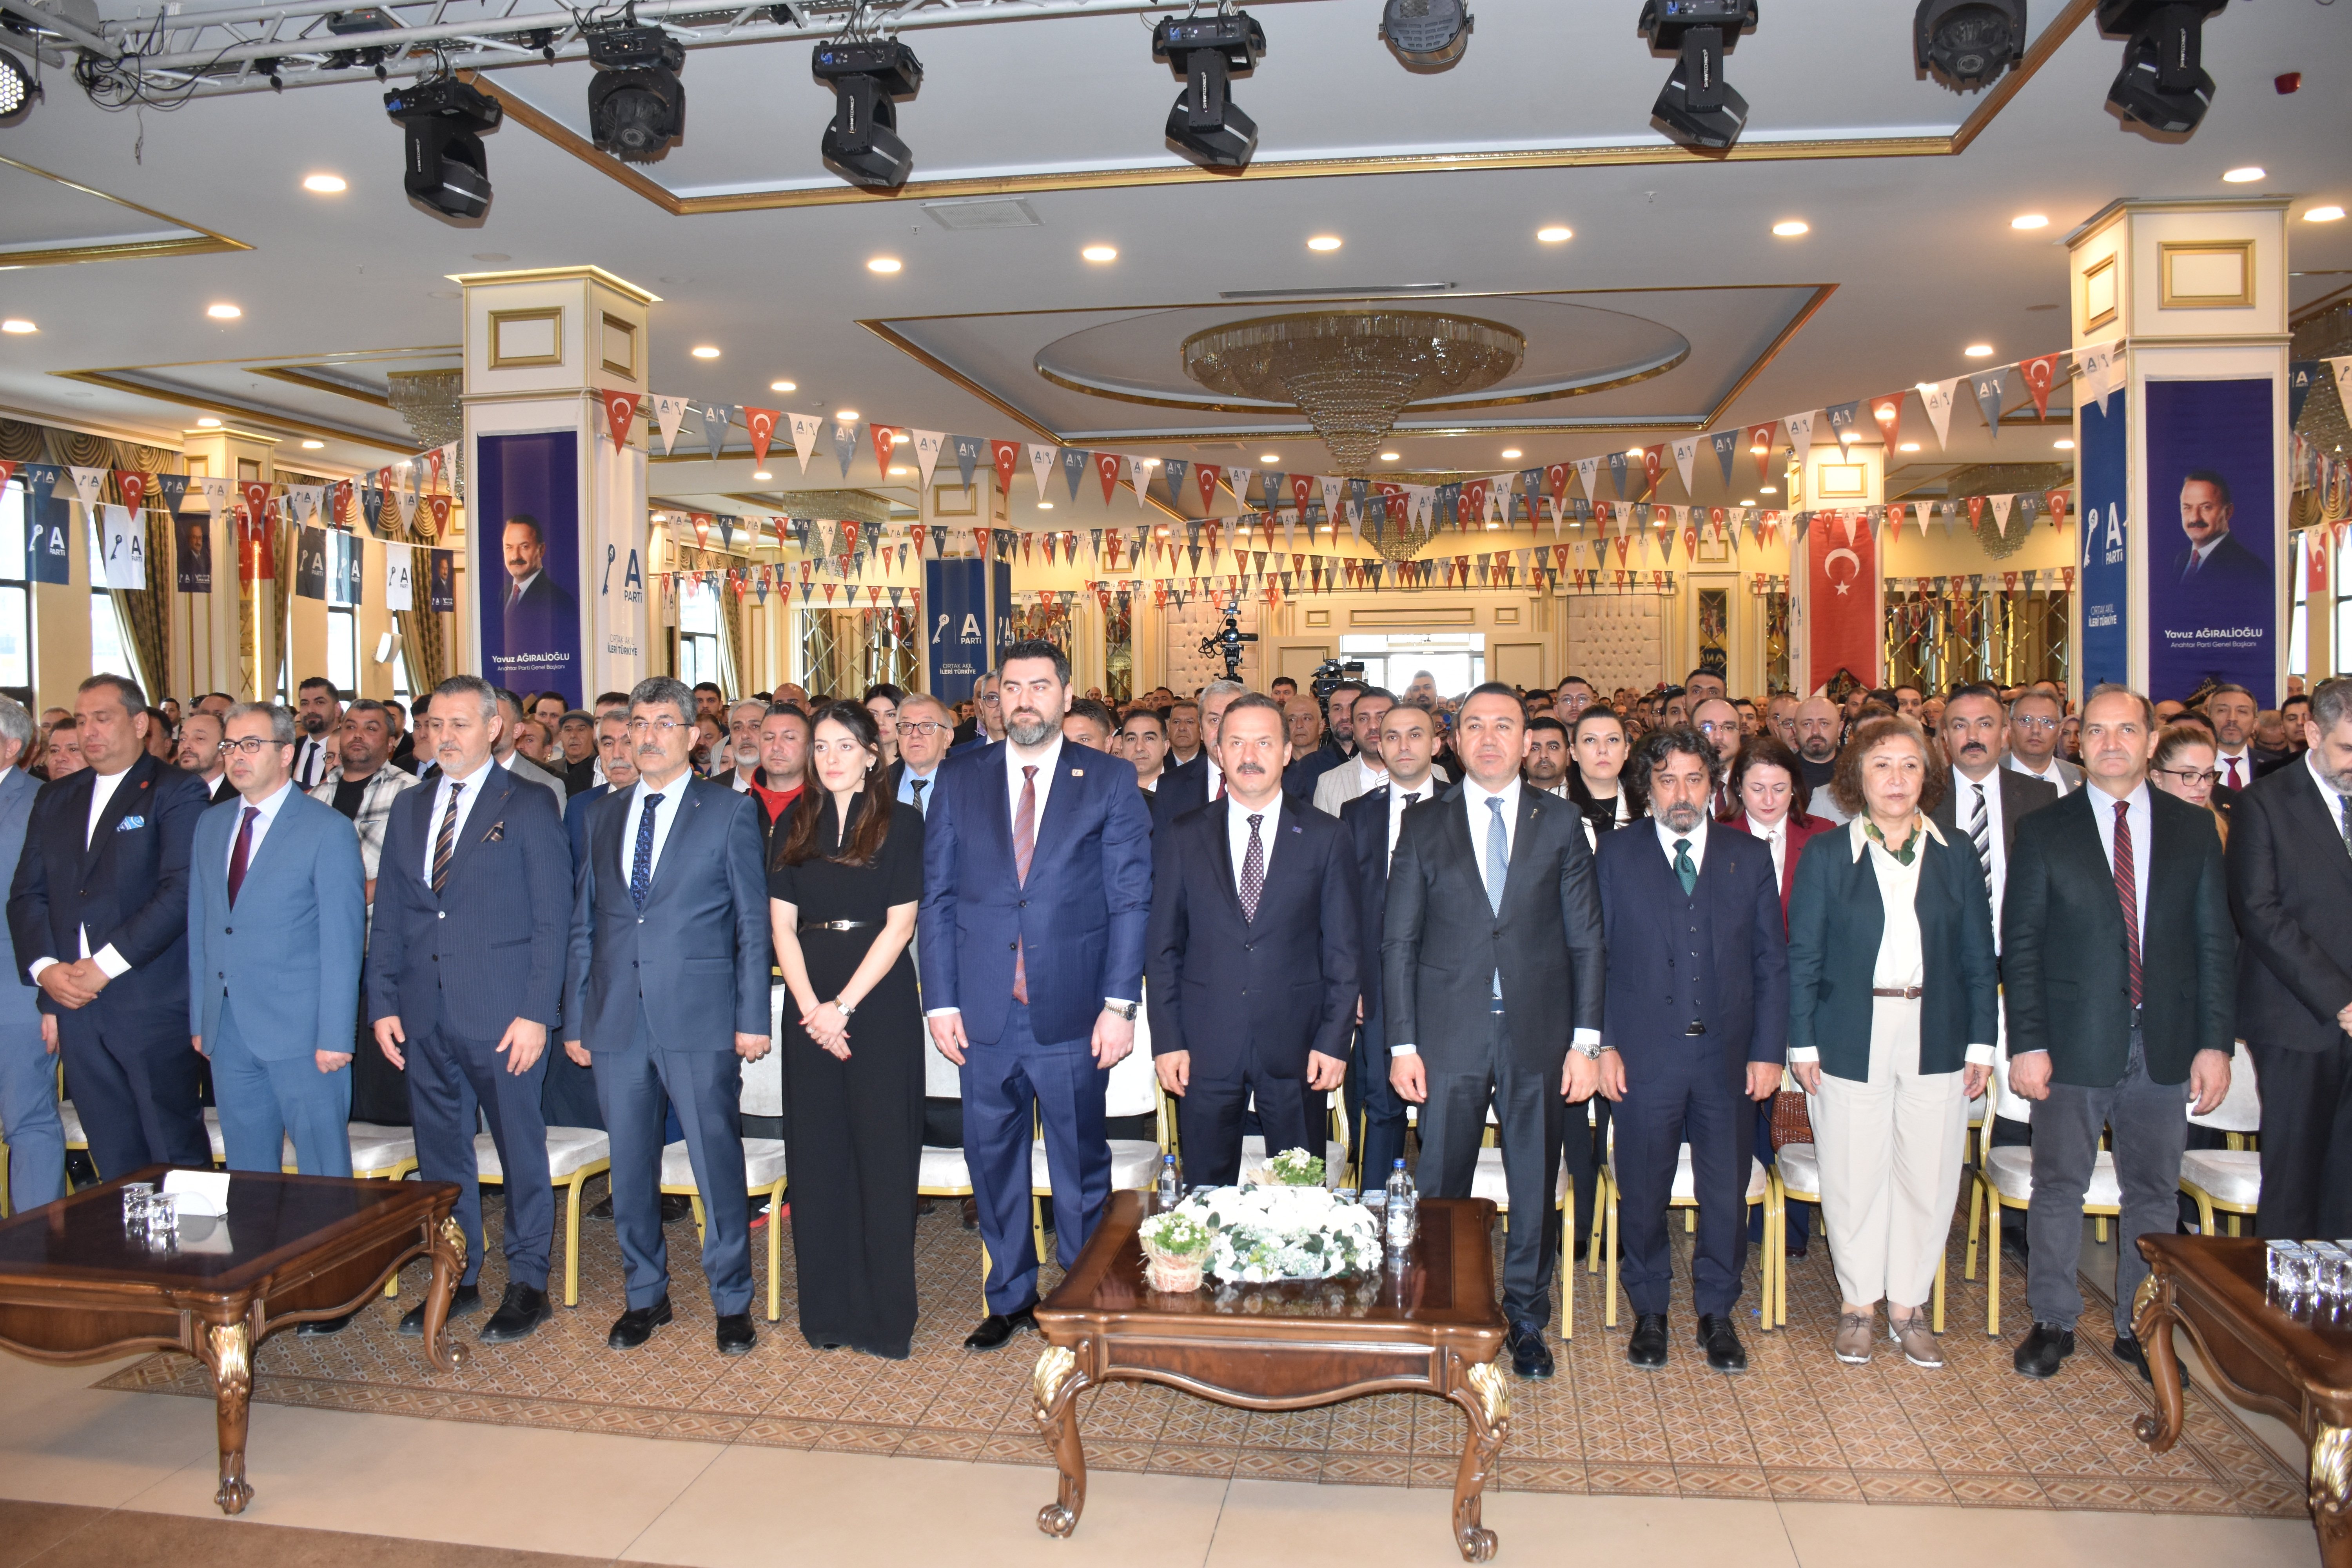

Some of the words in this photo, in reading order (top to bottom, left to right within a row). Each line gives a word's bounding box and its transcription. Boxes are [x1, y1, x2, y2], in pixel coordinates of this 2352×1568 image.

[2296, 371, 2307, 383] A
[46, 472, 54, 481] A
[91, 476, 99, 485] A
[176, 482, 183, 490] A
[218, 485, 224, 494] A
[2106, 502, 2122, 550] A
[50, 527, 65, 549] A
[132, 535, 142, 555] A
[312, 553, 323, 570] A
[352, 560, 360, 577] A
[625, 549, 642, 589] A
[401, 568, 408, 583] A
[670, 594, 673, 605] A
[961, 614, 981, 636] A
[1005, 617, 1011, 639] A
[2165, 630, 2193, 638] Yavuz
[2195, 627, 2263, 638] AĞIRALİOĞLU
[517, 652, 570, 662] AĞIRALİOĞLU
